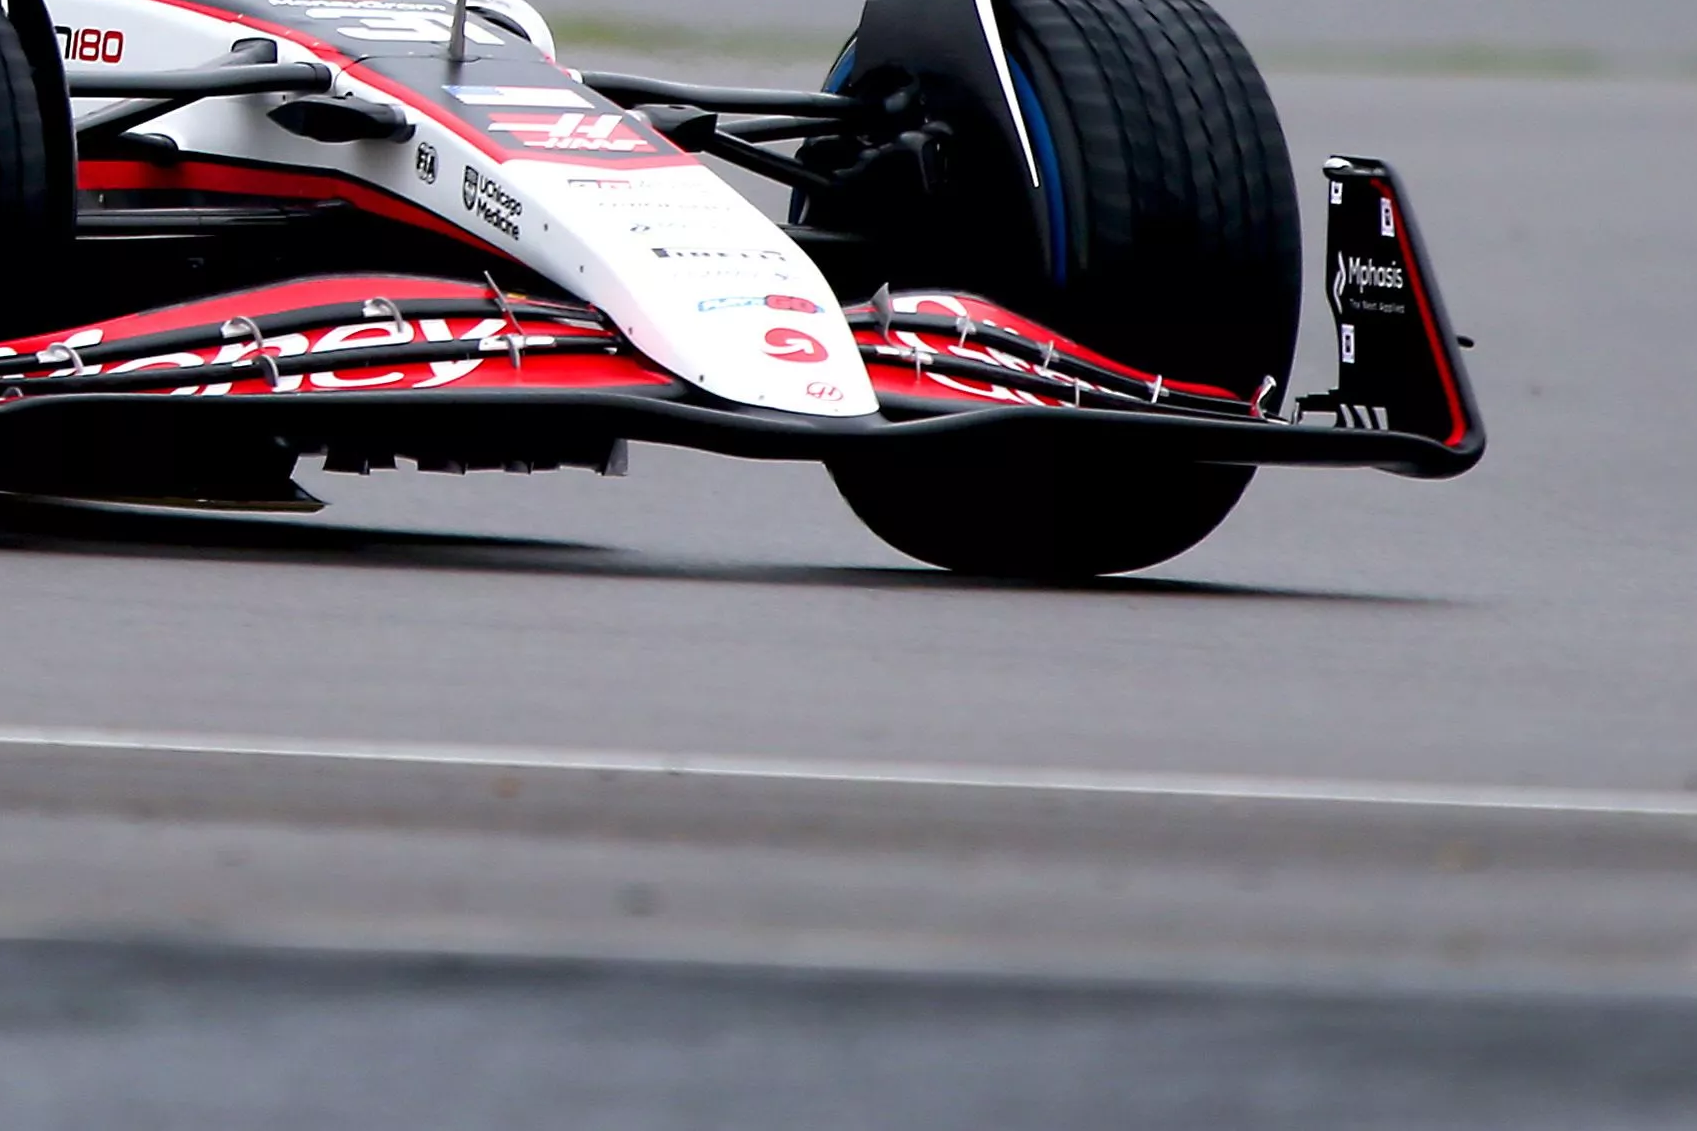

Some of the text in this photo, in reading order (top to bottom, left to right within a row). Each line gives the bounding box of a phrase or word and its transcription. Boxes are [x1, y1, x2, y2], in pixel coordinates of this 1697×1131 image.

[478, 173, 523, 217] UChicago
[475, 198, 521, 241] Medicine
[1349, 257, 1403, 293] Mphasis
